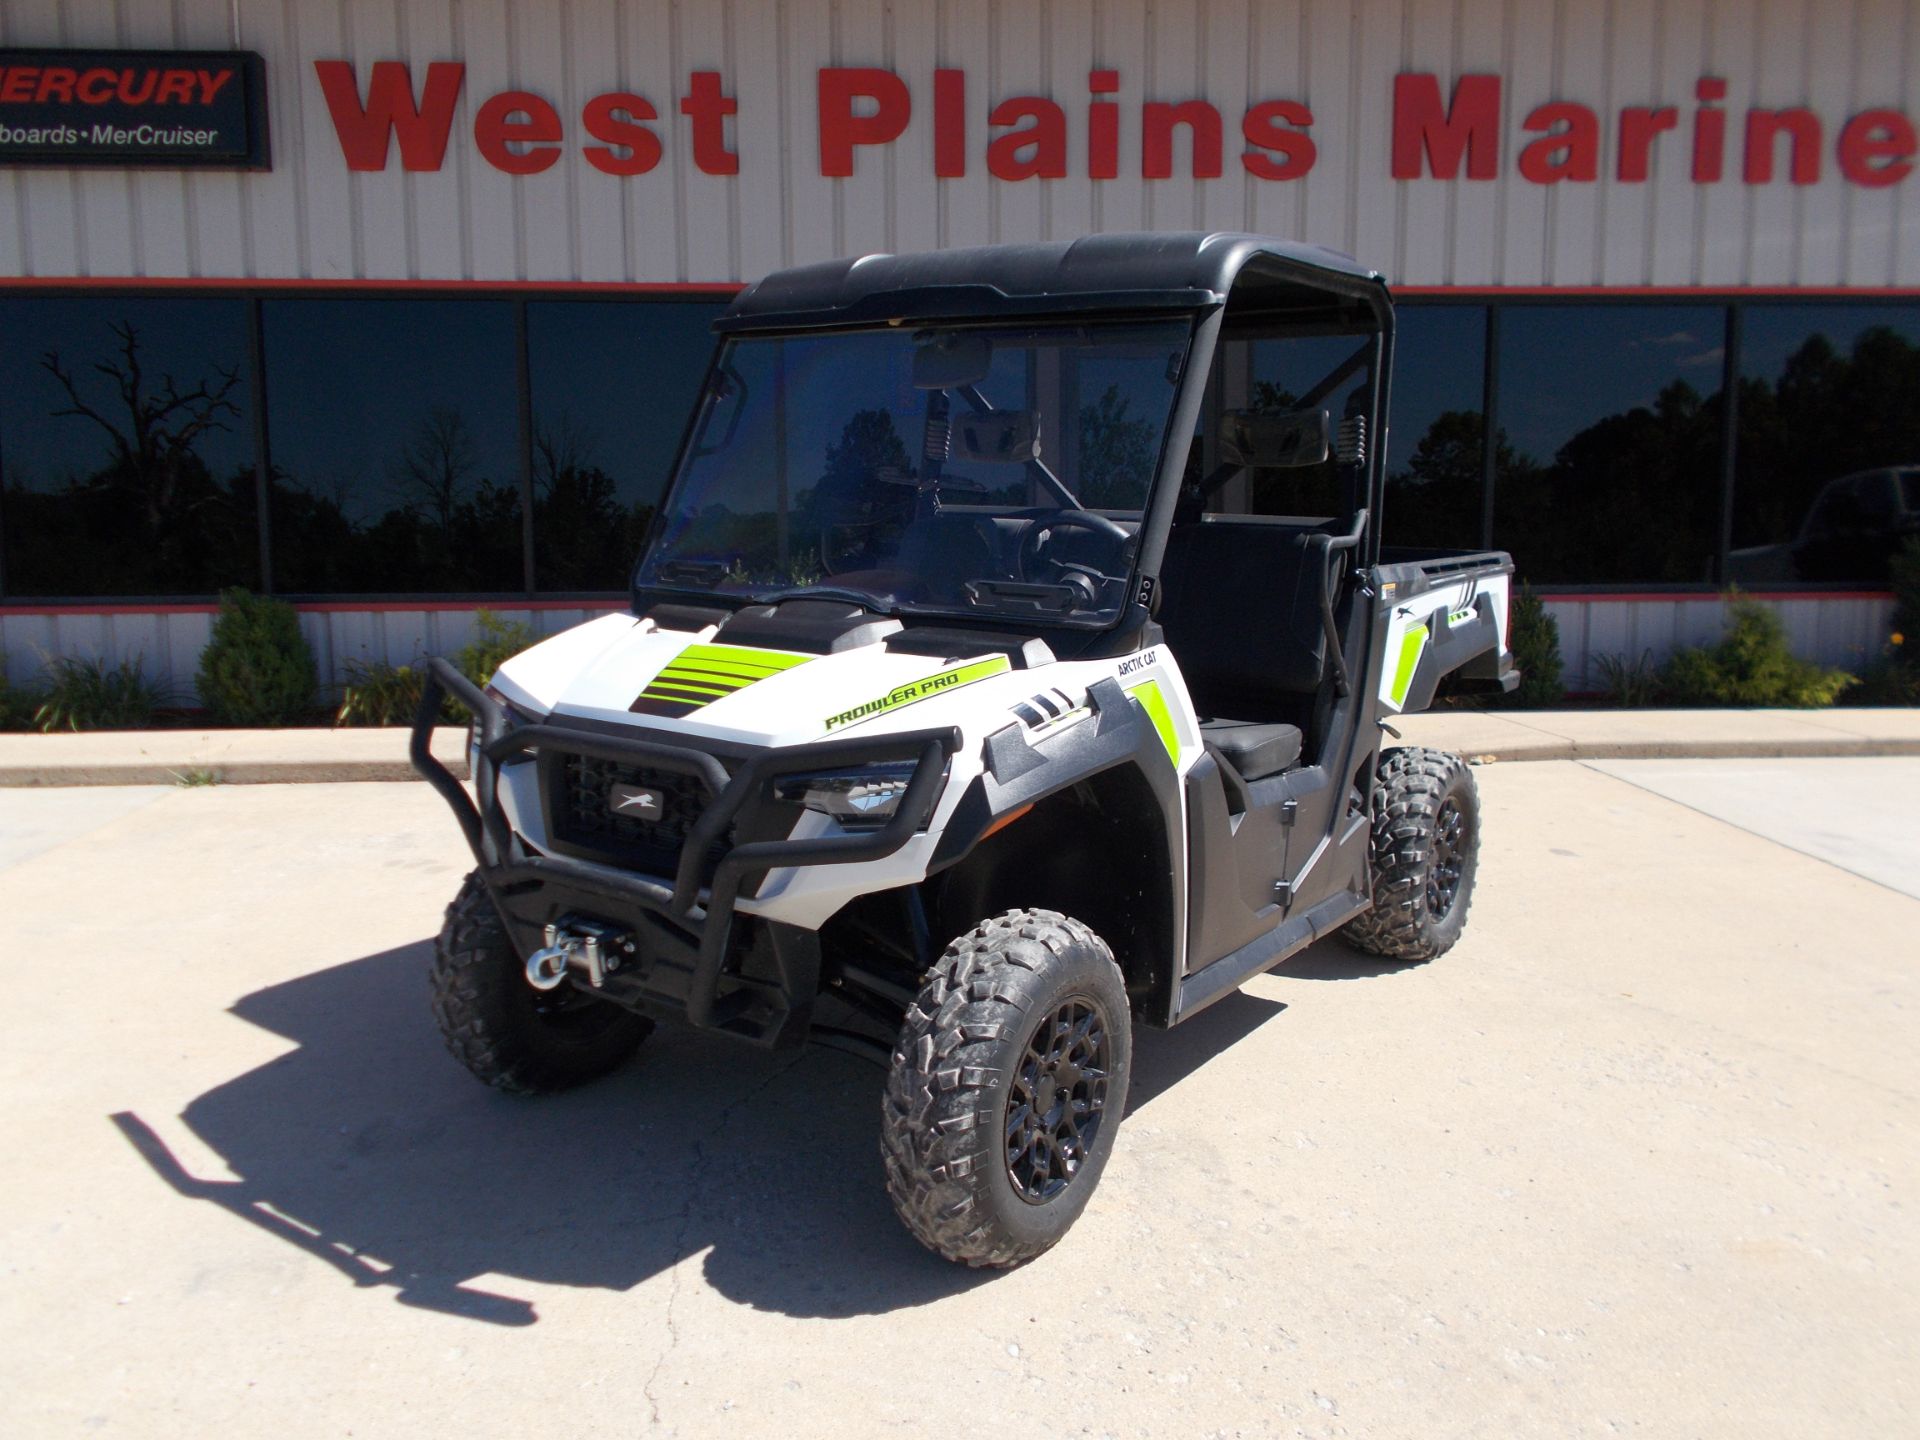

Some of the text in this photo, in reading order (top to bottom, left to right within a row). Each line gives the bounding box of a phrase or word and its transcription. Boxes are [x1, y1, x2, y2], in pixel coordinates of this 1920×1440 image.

[0, 66, 234, 106] ERCURY
[314, 60, 1917, 189] West Plains Marine
[1117, 650, 1157, 677] ARCTIC CAT
[824, 673, 960, 731] PROWLER PRO
